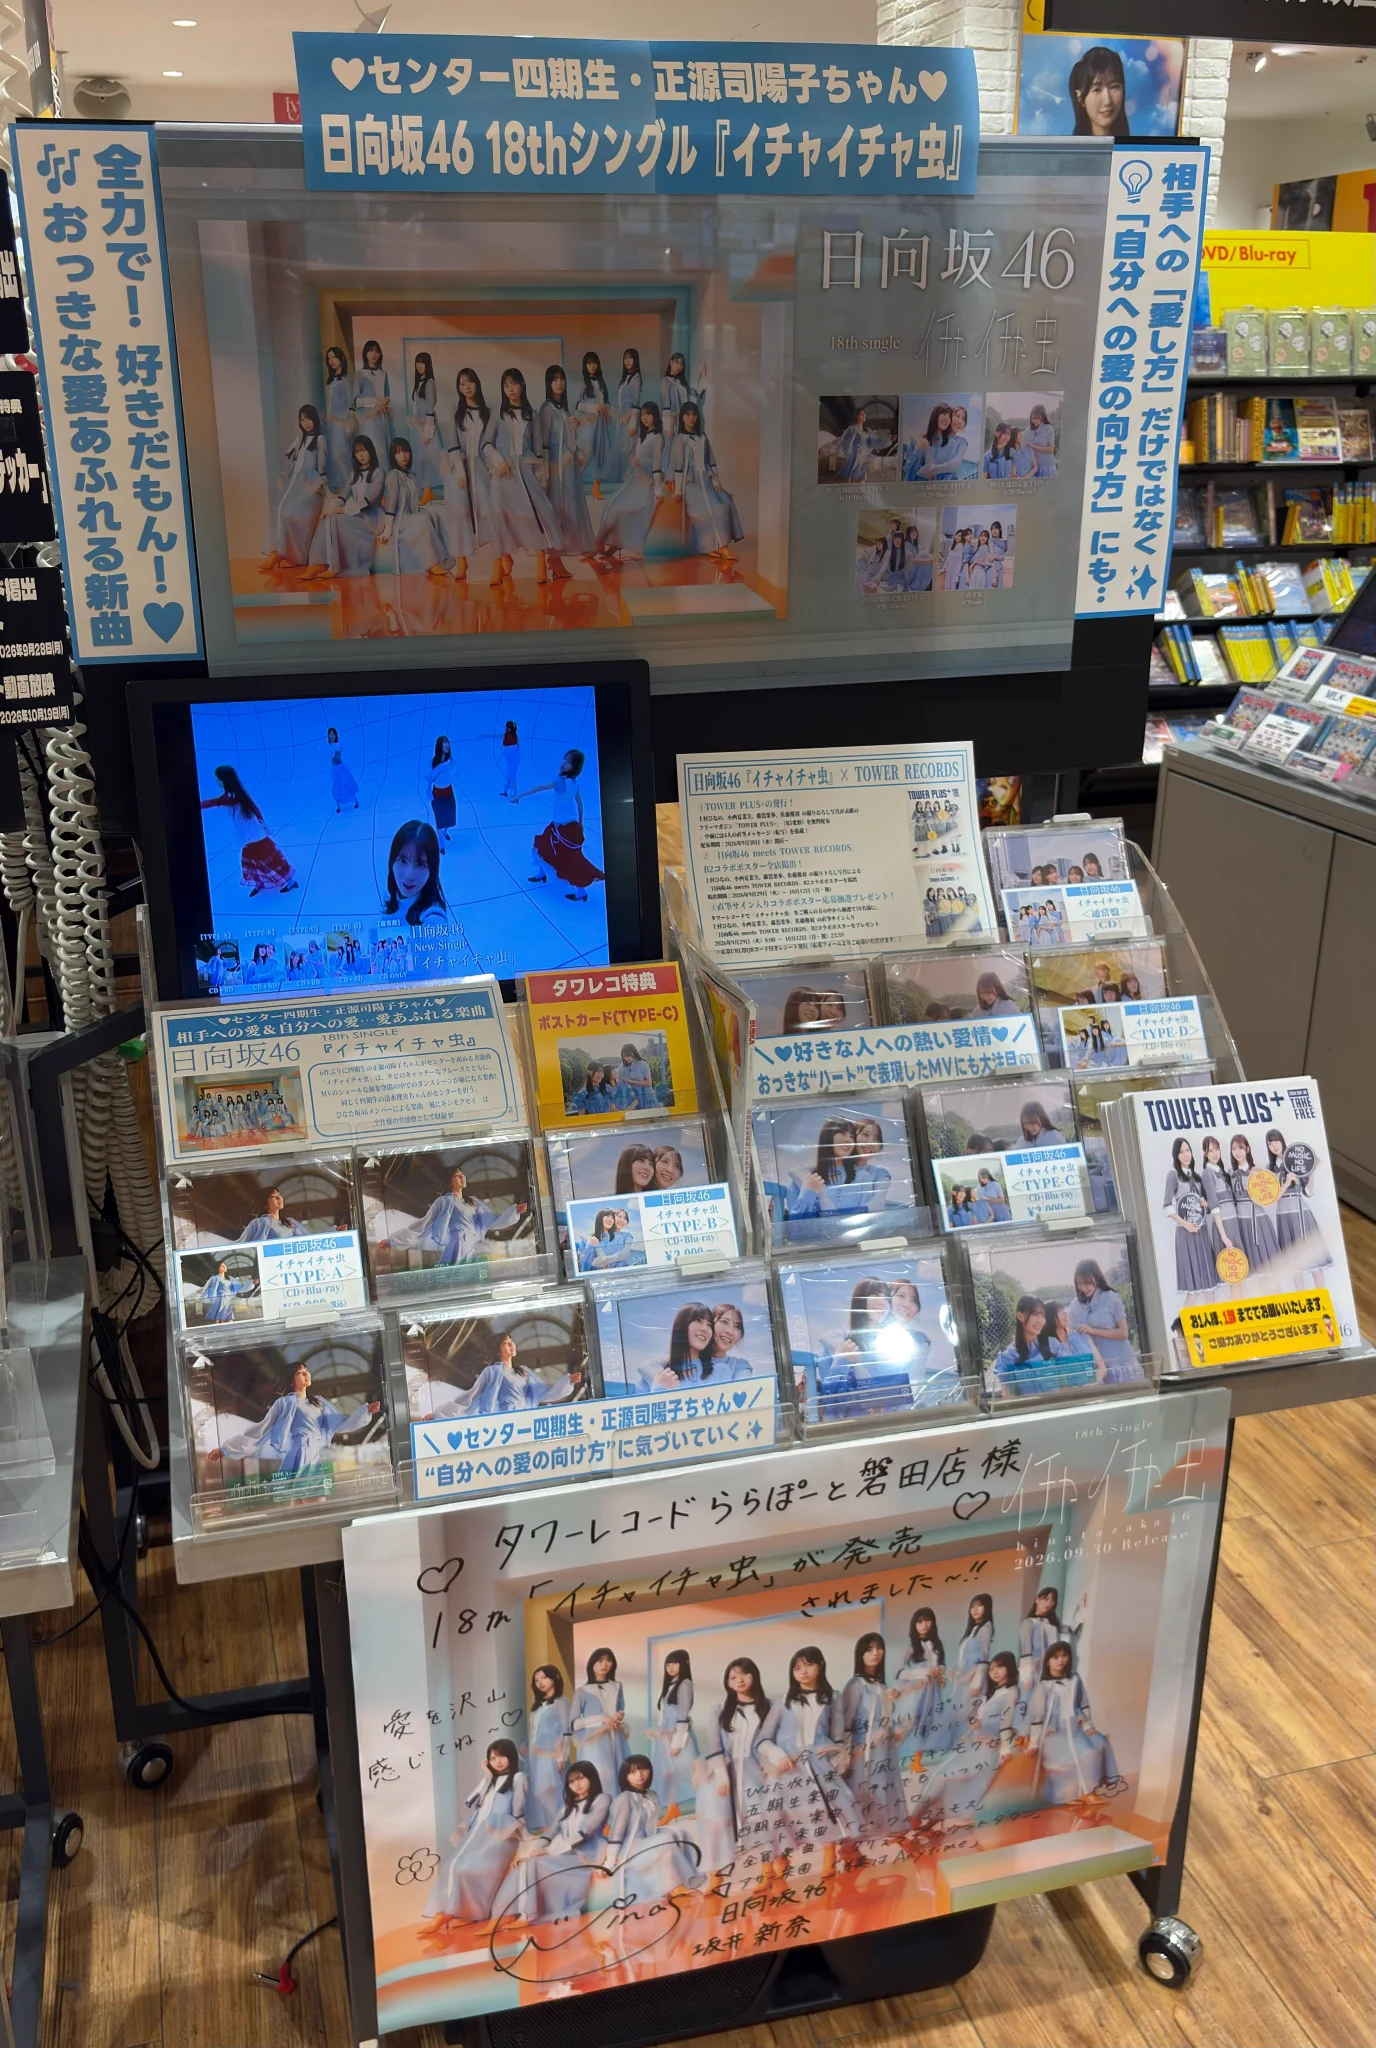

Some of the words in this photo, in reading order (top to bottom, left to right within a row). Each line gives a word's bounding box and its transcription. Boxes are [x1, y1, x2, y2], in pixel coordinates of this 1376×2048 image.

[367, 57, 916, 104] センター四期生・正源司陽子ちゃん
[321, 115, 474, 176] 日向坂46
[485, 117, 963, 181] 18thシングル『イチャイチャ虫』
[821, 227, 1077, 290] 日向坂46
[0, 250, 20, 299] 出
[830, 335, 859, 350] 18th
[862, 335, 900, 354] single
[1134, 163, 1198, 556] 相手への「愛し方」だけではなく
[43, 203, 132, 646] おっきな愛あふれる新曲
[0, 577, 38, 602] 掲出
[0, 672, 56, 700] 動画放映
[854, 767, 899, 783] TOWER
[904, 761, 959, 780] RECORDS
[753, 849, 777, 858] meets
[780, 847, 810, 856] TOWER
[412, 922, 465, 939] 日向坂46
[414, 942, 435, 952] New
[438, 940, 469, 952] Single
[378, 972, 389, 980] CD
[390, 970, 408, 979] ONLY
[552, 972, 657, 997] タワレコ特典
[231, 998, 435, 1024] センター四期生・正源司陽子ちゃん
[539, 1005, 679, 1031] ポストカード(TYPE-C)
[1139, 1001, 1182, 1014] 日向坂46
[323, 1032, 350, 1041] 18th
[352, 1028, 399, 1038] SINGLE
[323, 1033, 476, 1058] 『イチャイチャ虫』
[794, 1026, 991, 1063] 好きな人への熱い愛情
[172, 1040, 300, 1073] 日向坂46
[1144, 1096, 1216, 1132] TOWER
[1217, 1091, 1284, 1126] PLUS+
[1294, 1107, 1316, 1120] FREE
[1021, 1149, 1066, 1164] 日向坂46
[1018, 1163, 1076, 1177] イチャイチャ虫
[661, 1189, 710, 1206] 日向坂46
[1259, 1193, 1273, 1201] LIFE
[656, 1205, 719, 1219] イチャイチャ虫
[282, 1238, 337, 1256] 日向坂46
[277, 1254, 346, 1270] イチャイチャ虫
[1225, 1271, 1240, 1279] LIFE
[1209, 1323, 1323, 1349] ご協力ありがとうございます。
[464, 1393, 735, 1449] センター四期生・正源司陽子ちゃん
[1074, 1426, 1103, 1440] 18th
[1109, 1420, 1154, 1436] Single
[1014, 1542, 1112, 1571] 2026.09.30
[1121, 1531, 1189, 1550] Release
[384, 1689, 506, 1739] 愛を沢山
[722, 1882, 827, 1924] 日向坂46
